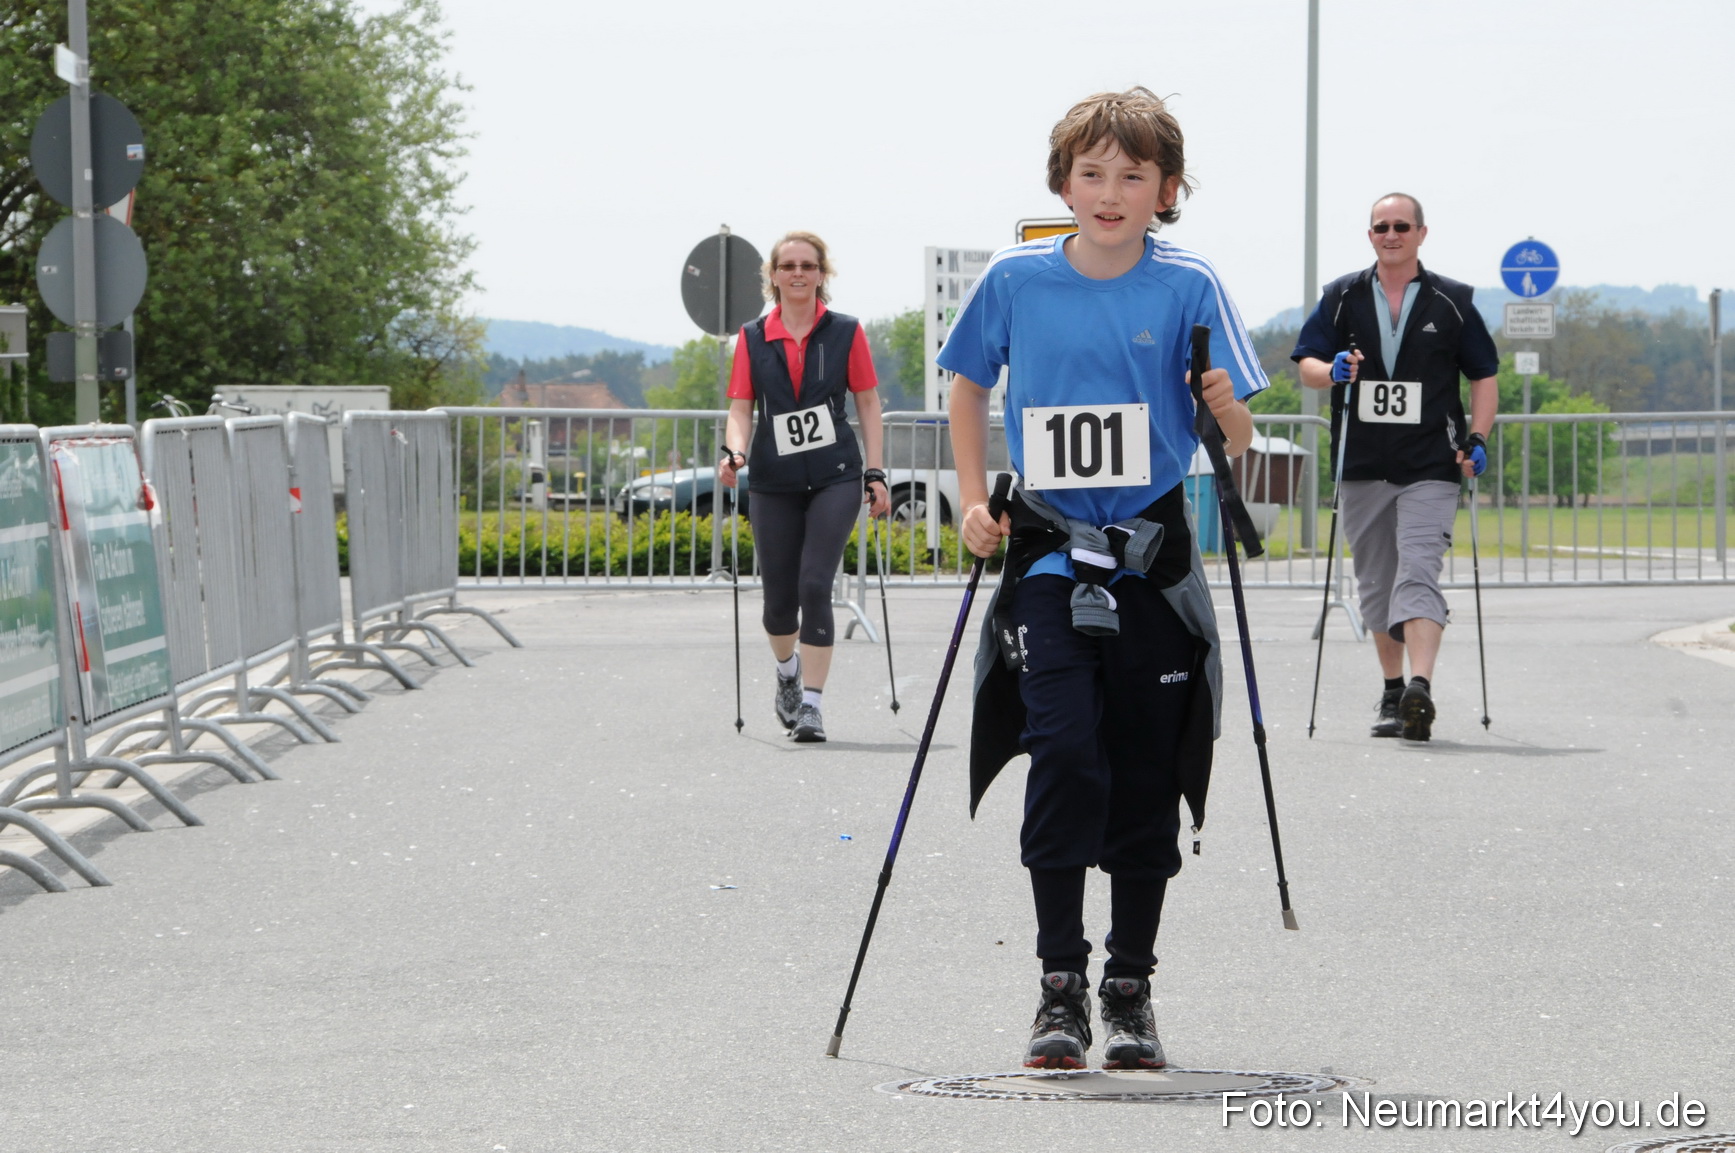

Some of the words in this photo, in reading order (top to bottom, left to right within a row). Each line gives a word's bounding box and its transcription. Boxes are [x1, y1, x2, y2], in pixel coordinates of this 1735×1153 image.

[1512, 306, 1547, 315] Landwirt-
[1509, 315, 1550, 324] schaftlicher
[1509, 325, 1535, 333] Verkehr
[1538, 325, 1550, 333] frei
[1373, 383, 1407, 417] 93
[786, 410, 824, 447] 92
[1045, 412, 1124, 478] 101
[1160, 670, 1189, 684] erima
